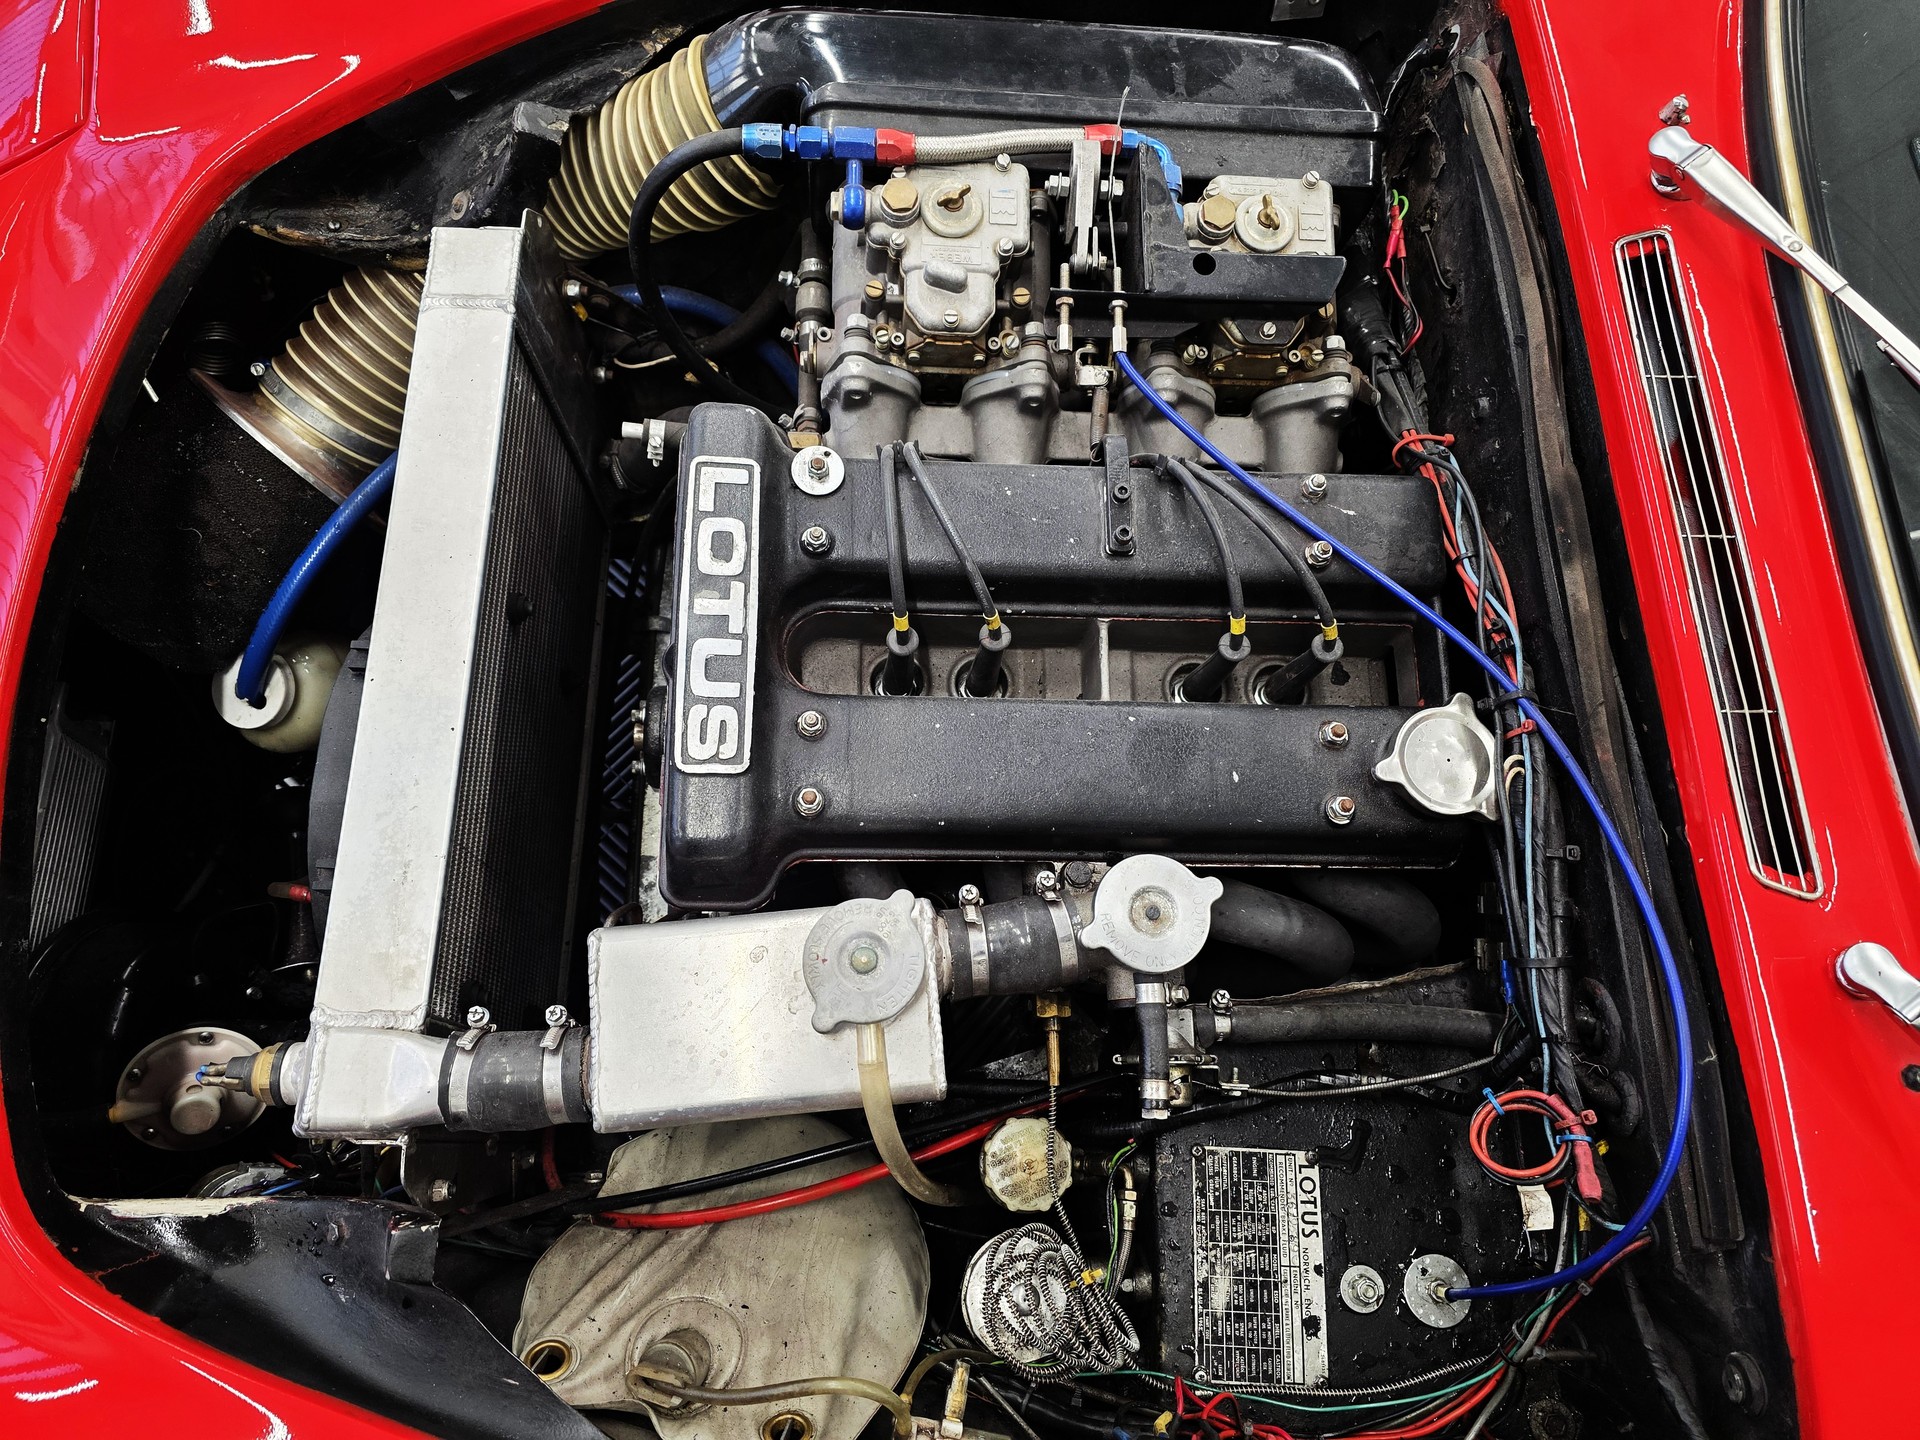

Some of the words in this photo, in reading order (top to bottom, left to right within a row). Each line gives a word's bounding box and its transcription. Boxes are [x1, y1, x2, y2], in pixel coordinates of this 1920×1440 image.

[929, 253, 972, 263] WEBER
[687, 466, 749, 761] LOTUS
[1100, 913, 1142, 963] REMOVE
[1145, 953, 1178, 968] ONLY
[1183, 920, 1207, 956] WHEN
[877, 951, 921, 1015] TIGHTEN
[1278, 1162, 1286, 1212] RECOMMENDED
[1298, 1164, 1319, 1239] LOTUS
[1302, 1247, 1310, 1293] NORWICH,
